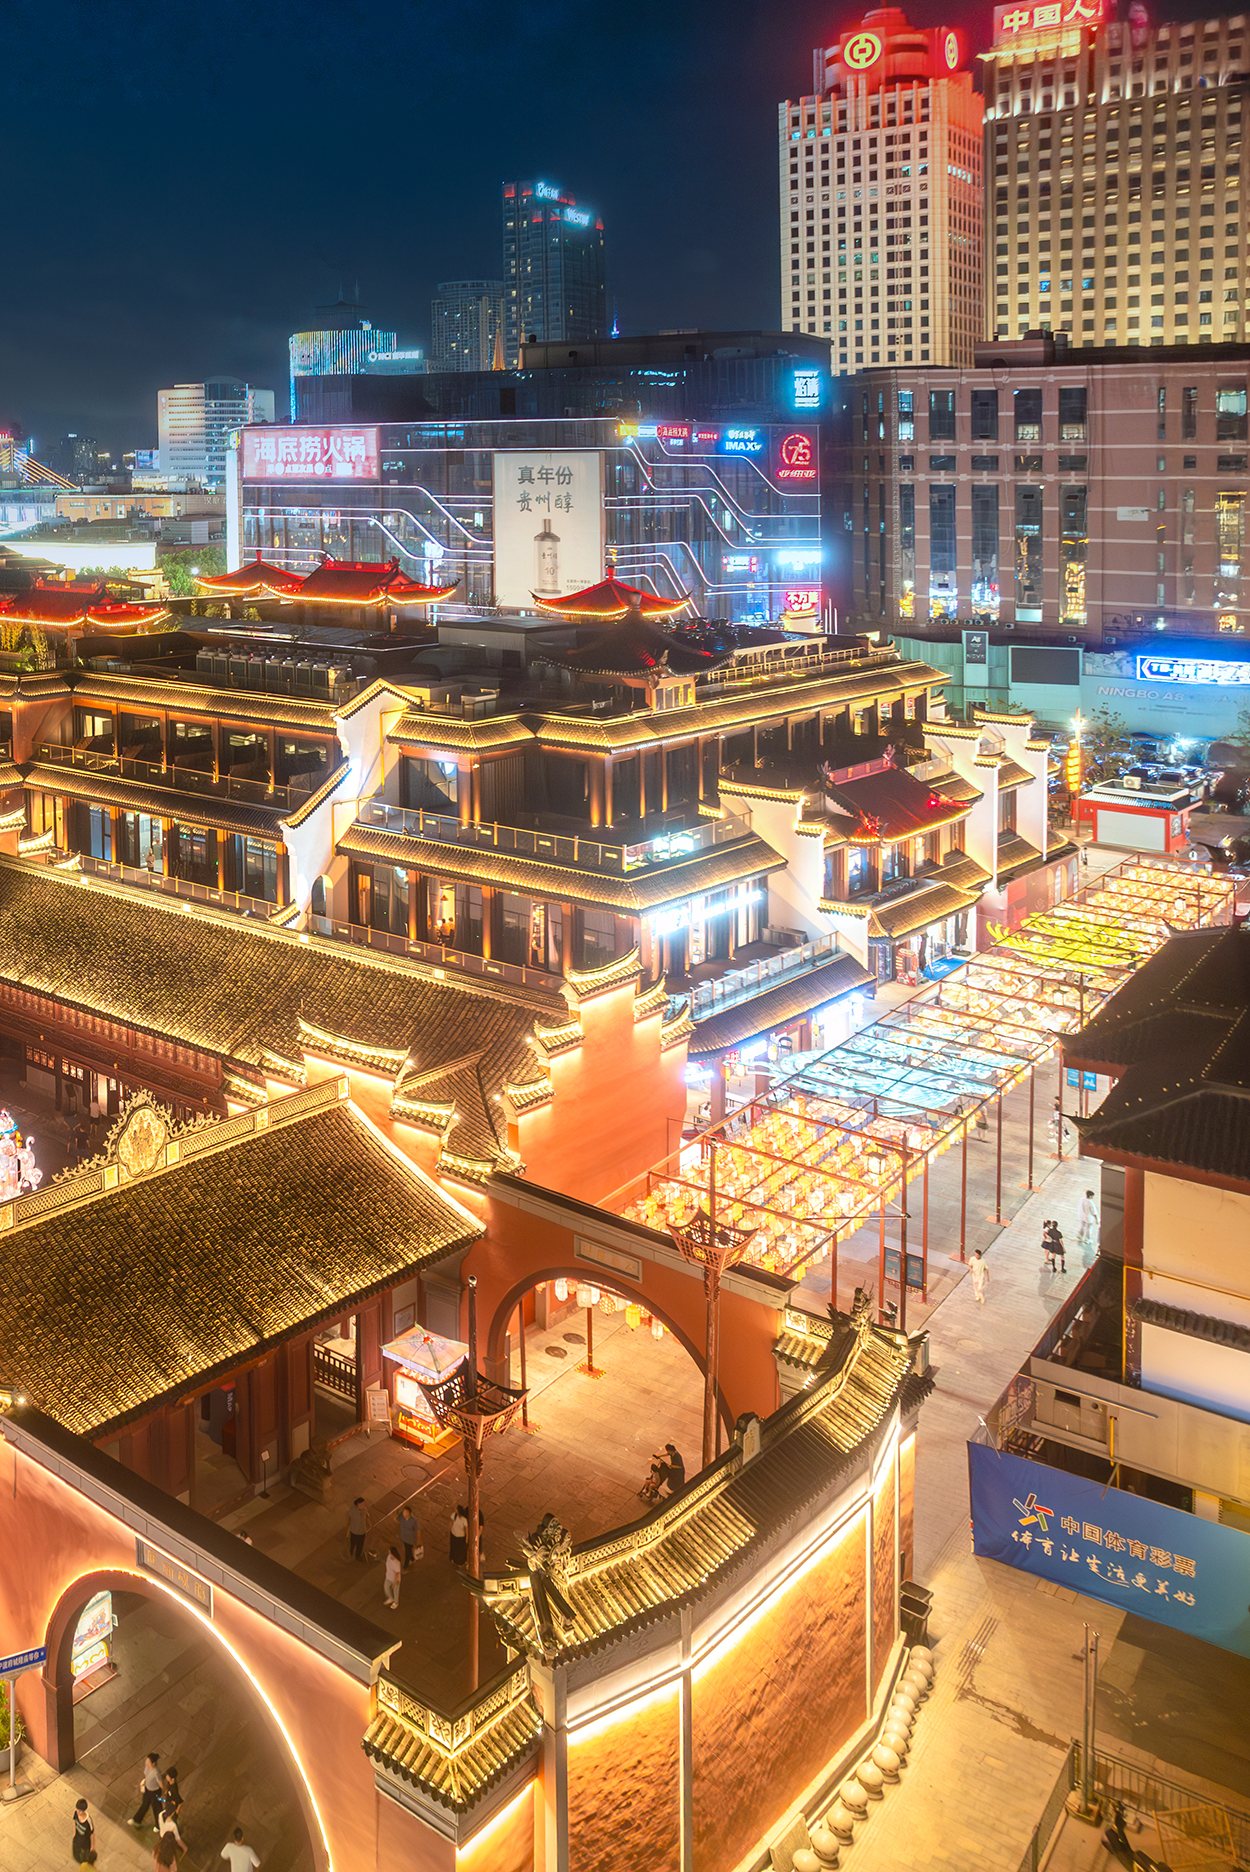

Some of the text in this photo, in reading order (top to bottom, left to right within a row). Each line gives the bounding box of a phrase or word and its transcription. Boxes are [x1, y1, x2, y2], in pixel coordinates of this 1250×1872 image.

[1002, 0, 1103, 33] 中国人
[253, 435, 366, 462] 海底捞火锅
[517, 465, 574, 486] 真年份
[516, 489, 574, 514] 贵州醇
[1098, 686, 1159, 700] NINGBO
[1060, 1515, 1197, 1578] 中国体育彩票
